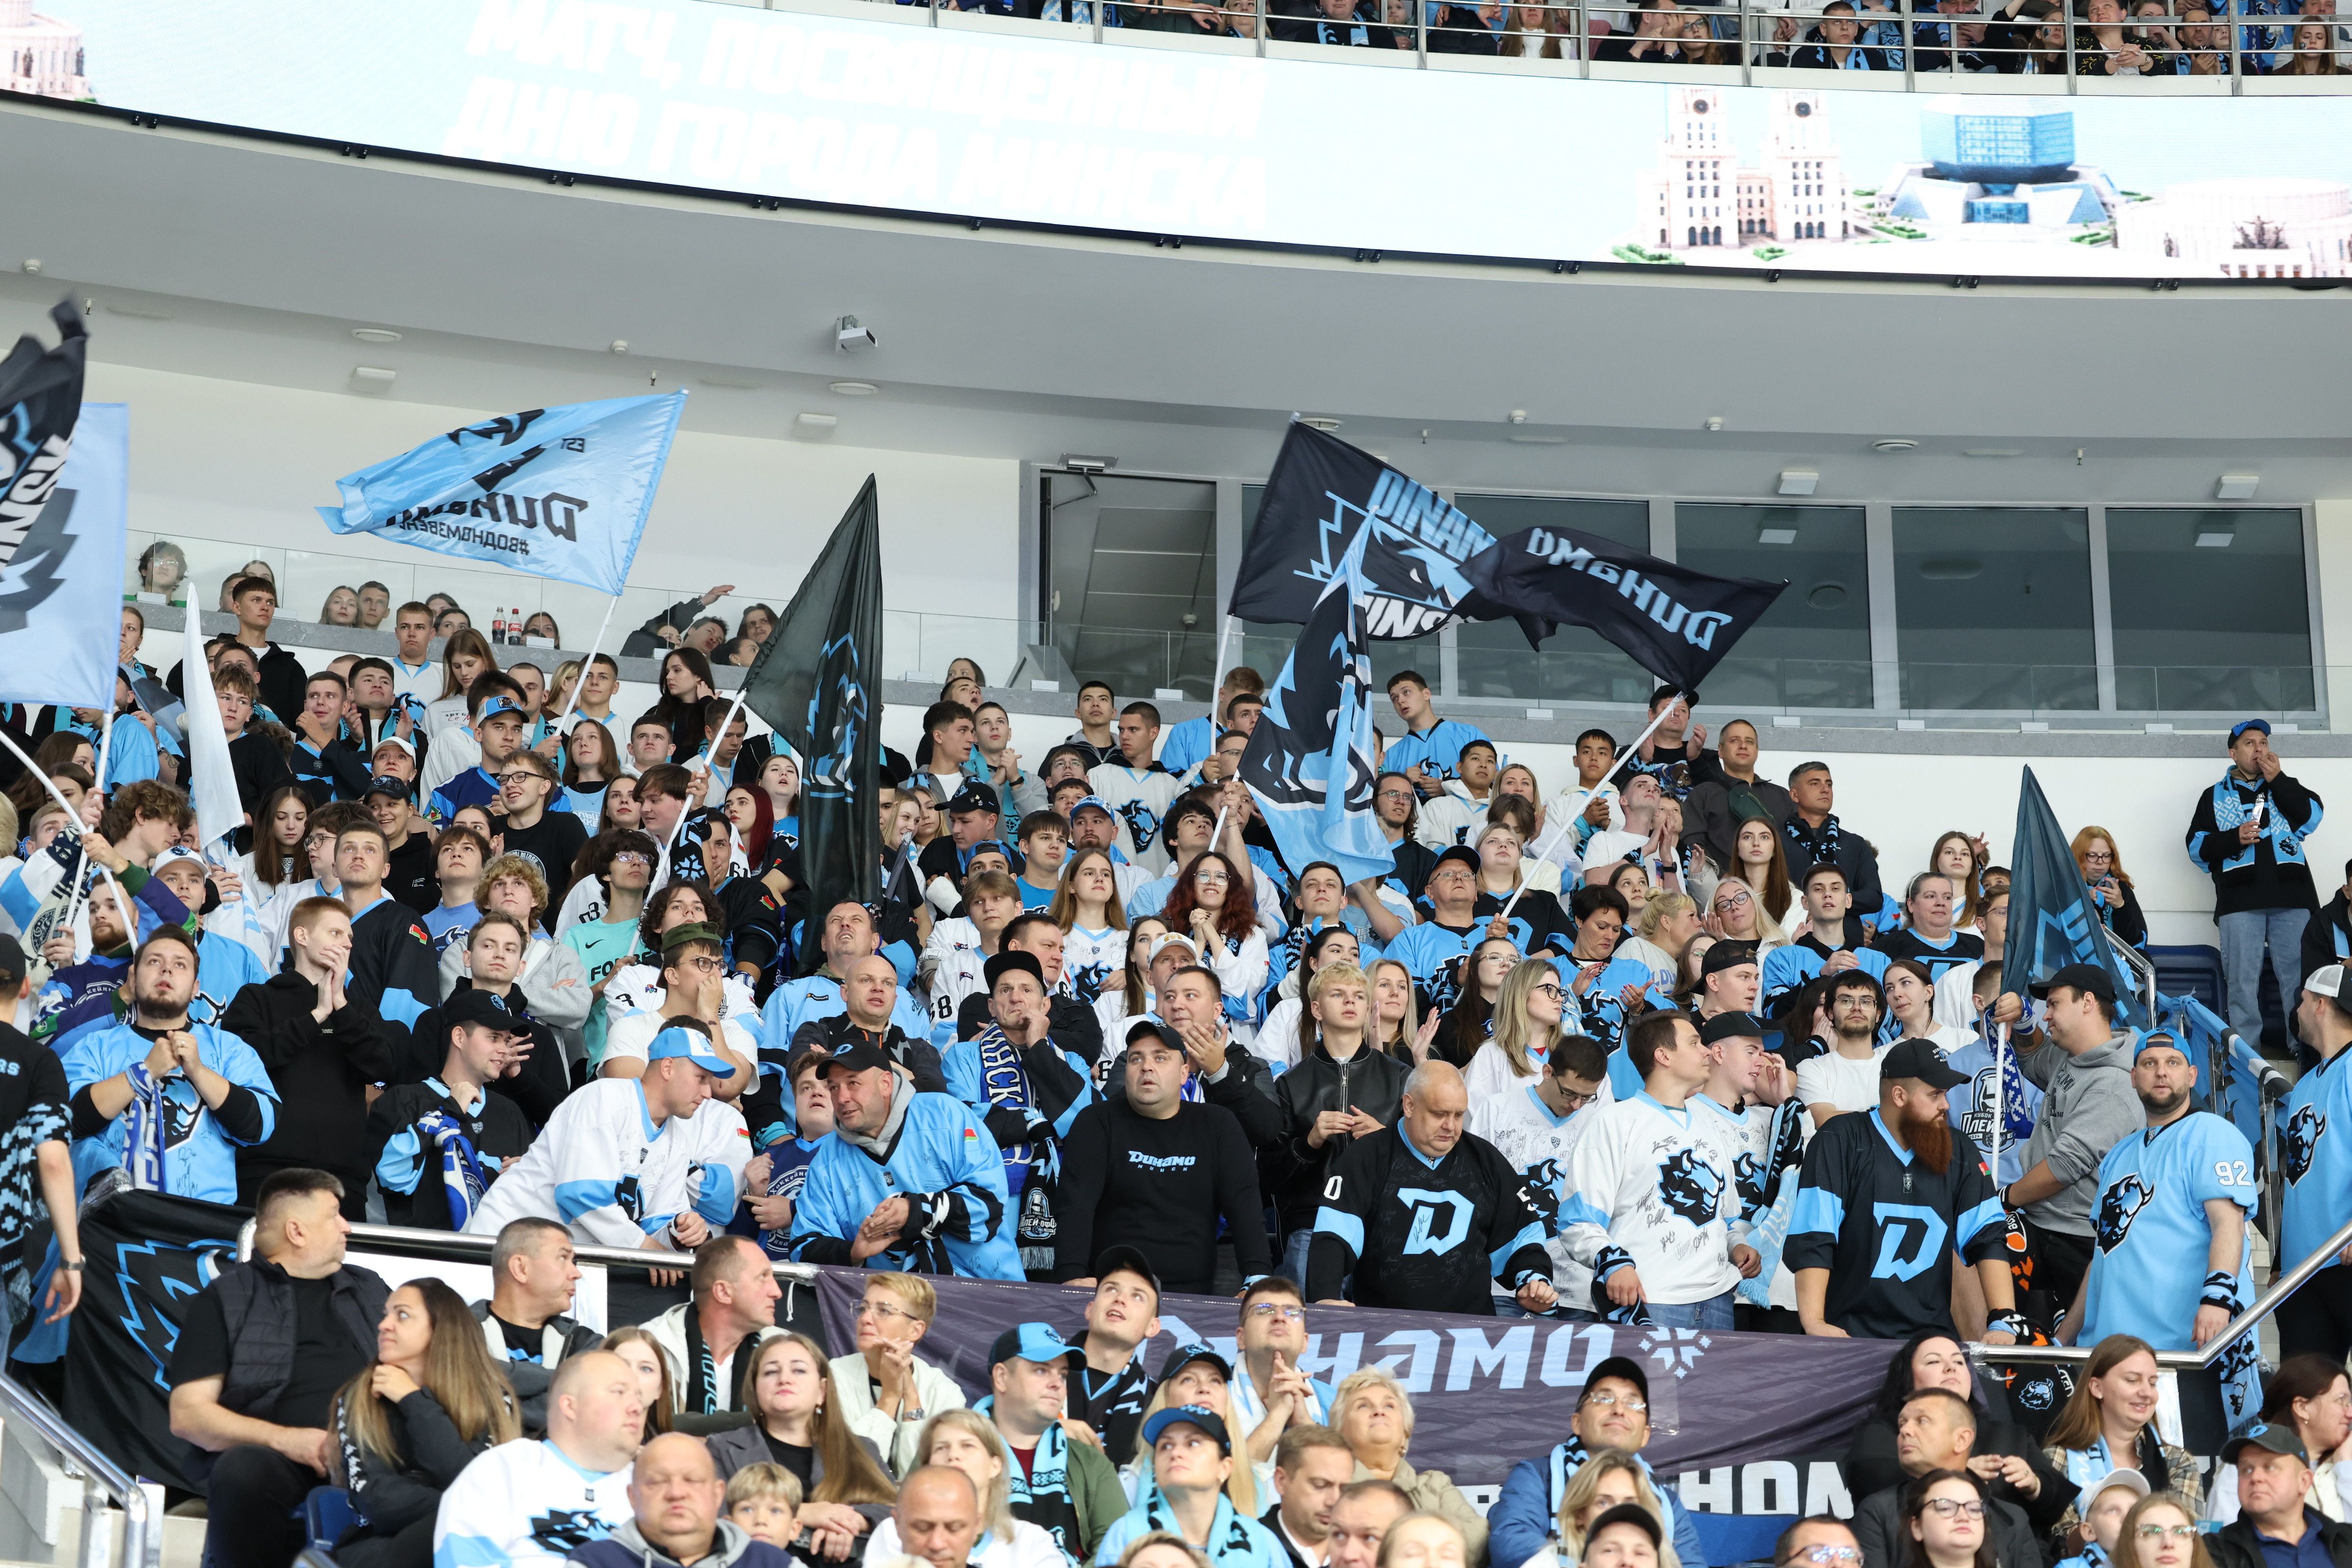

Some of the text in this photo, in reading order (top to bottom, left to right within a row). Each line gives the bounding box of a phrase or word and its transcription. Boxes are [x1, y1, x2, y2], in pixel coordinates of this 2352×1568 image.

[697, 17, 1270, 140] ПОСВЯЩЕННЫЙ
[646, 96, 945, 206] ГОРОДА
[947, 132, 1268, 230] МИНСКА
[2214, 1160, 2253, 1187] 92
